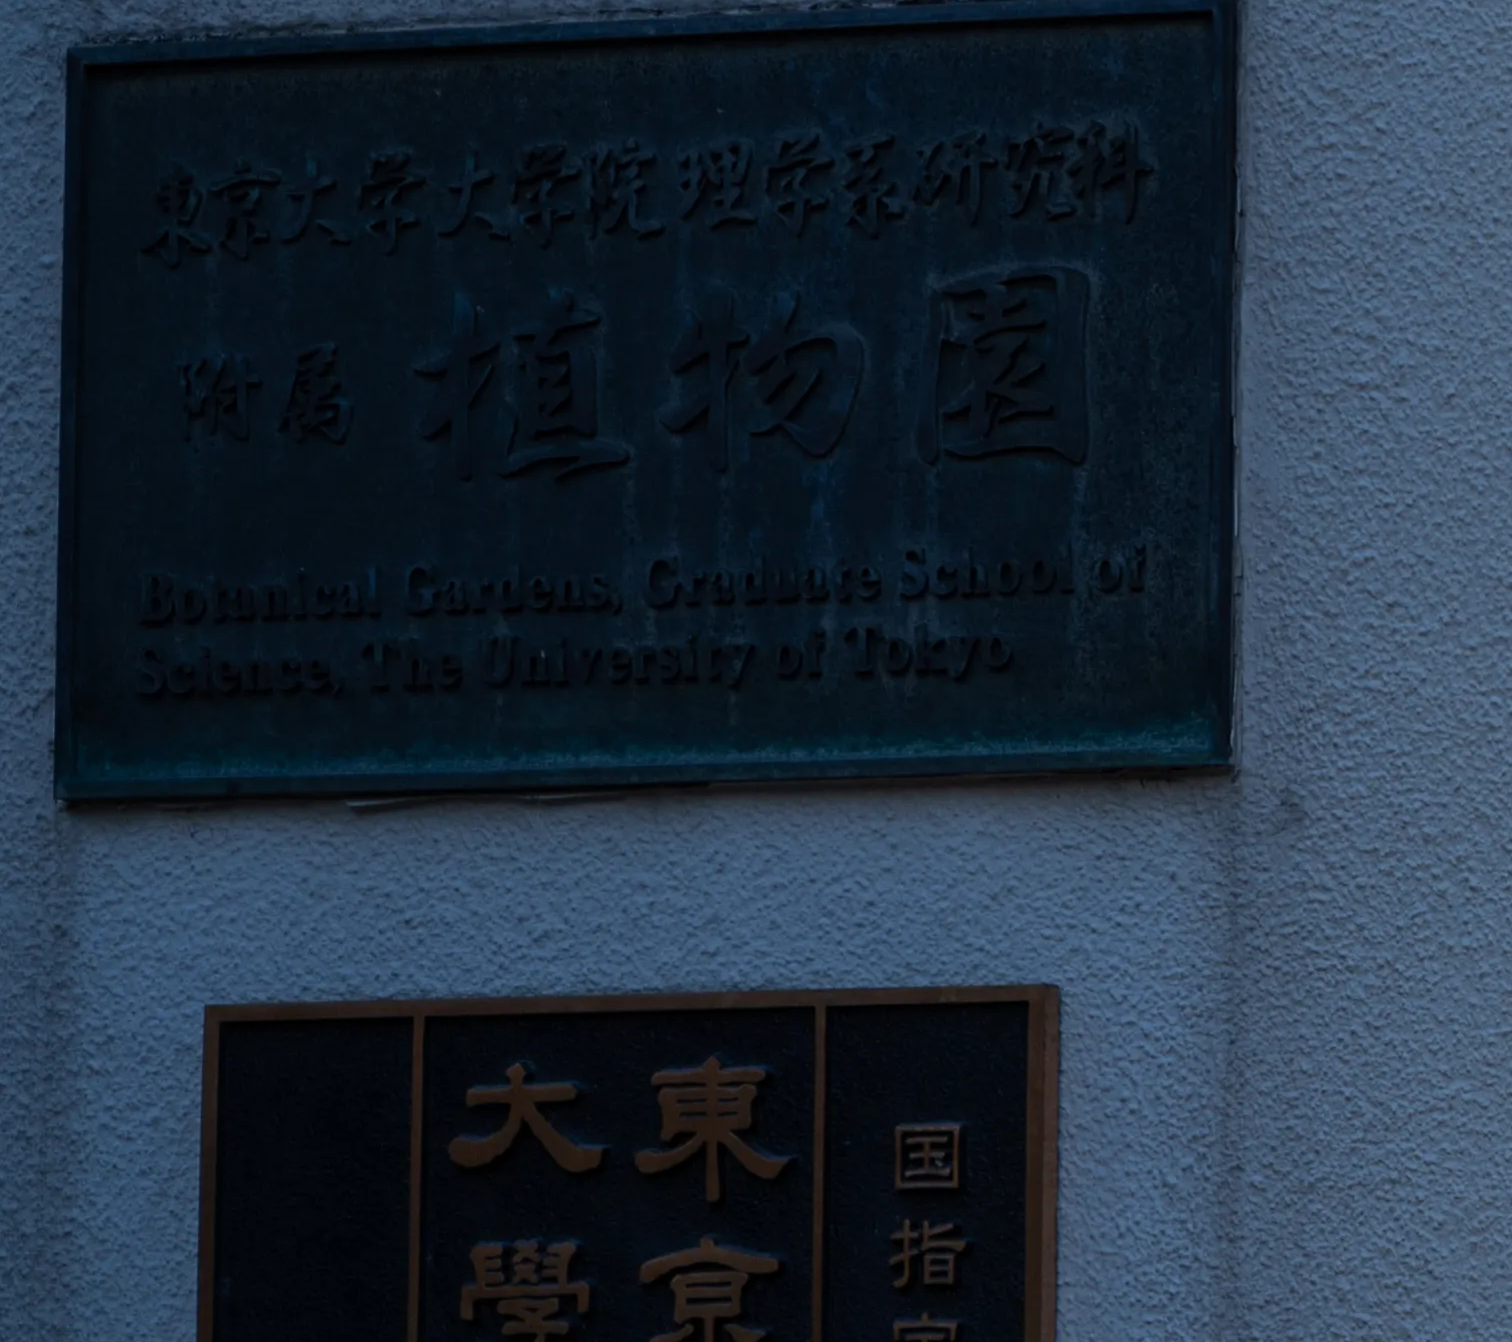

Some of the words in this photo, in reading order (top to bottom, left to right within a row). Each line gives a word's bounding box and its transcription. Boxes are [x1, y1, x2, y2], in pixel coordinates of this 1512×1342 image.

[140, 118, 1154, 267] 東京大学大学院理学系研究科
[139, 567, 382, 626] Botanical
[404, 563, 622, 616] Gardens,
[647, 557, 882, 609] Graduate
[898, 545, 1076, 600] School
[1098, 543, 1148, 593] of
[135, 643, 346, 699] Science,
[361, 637, 463, 695] The
[484, 629, 756, 689] University
[776, 629, 827, 679] of
[843, 622, 1014, 683] Tokyo
